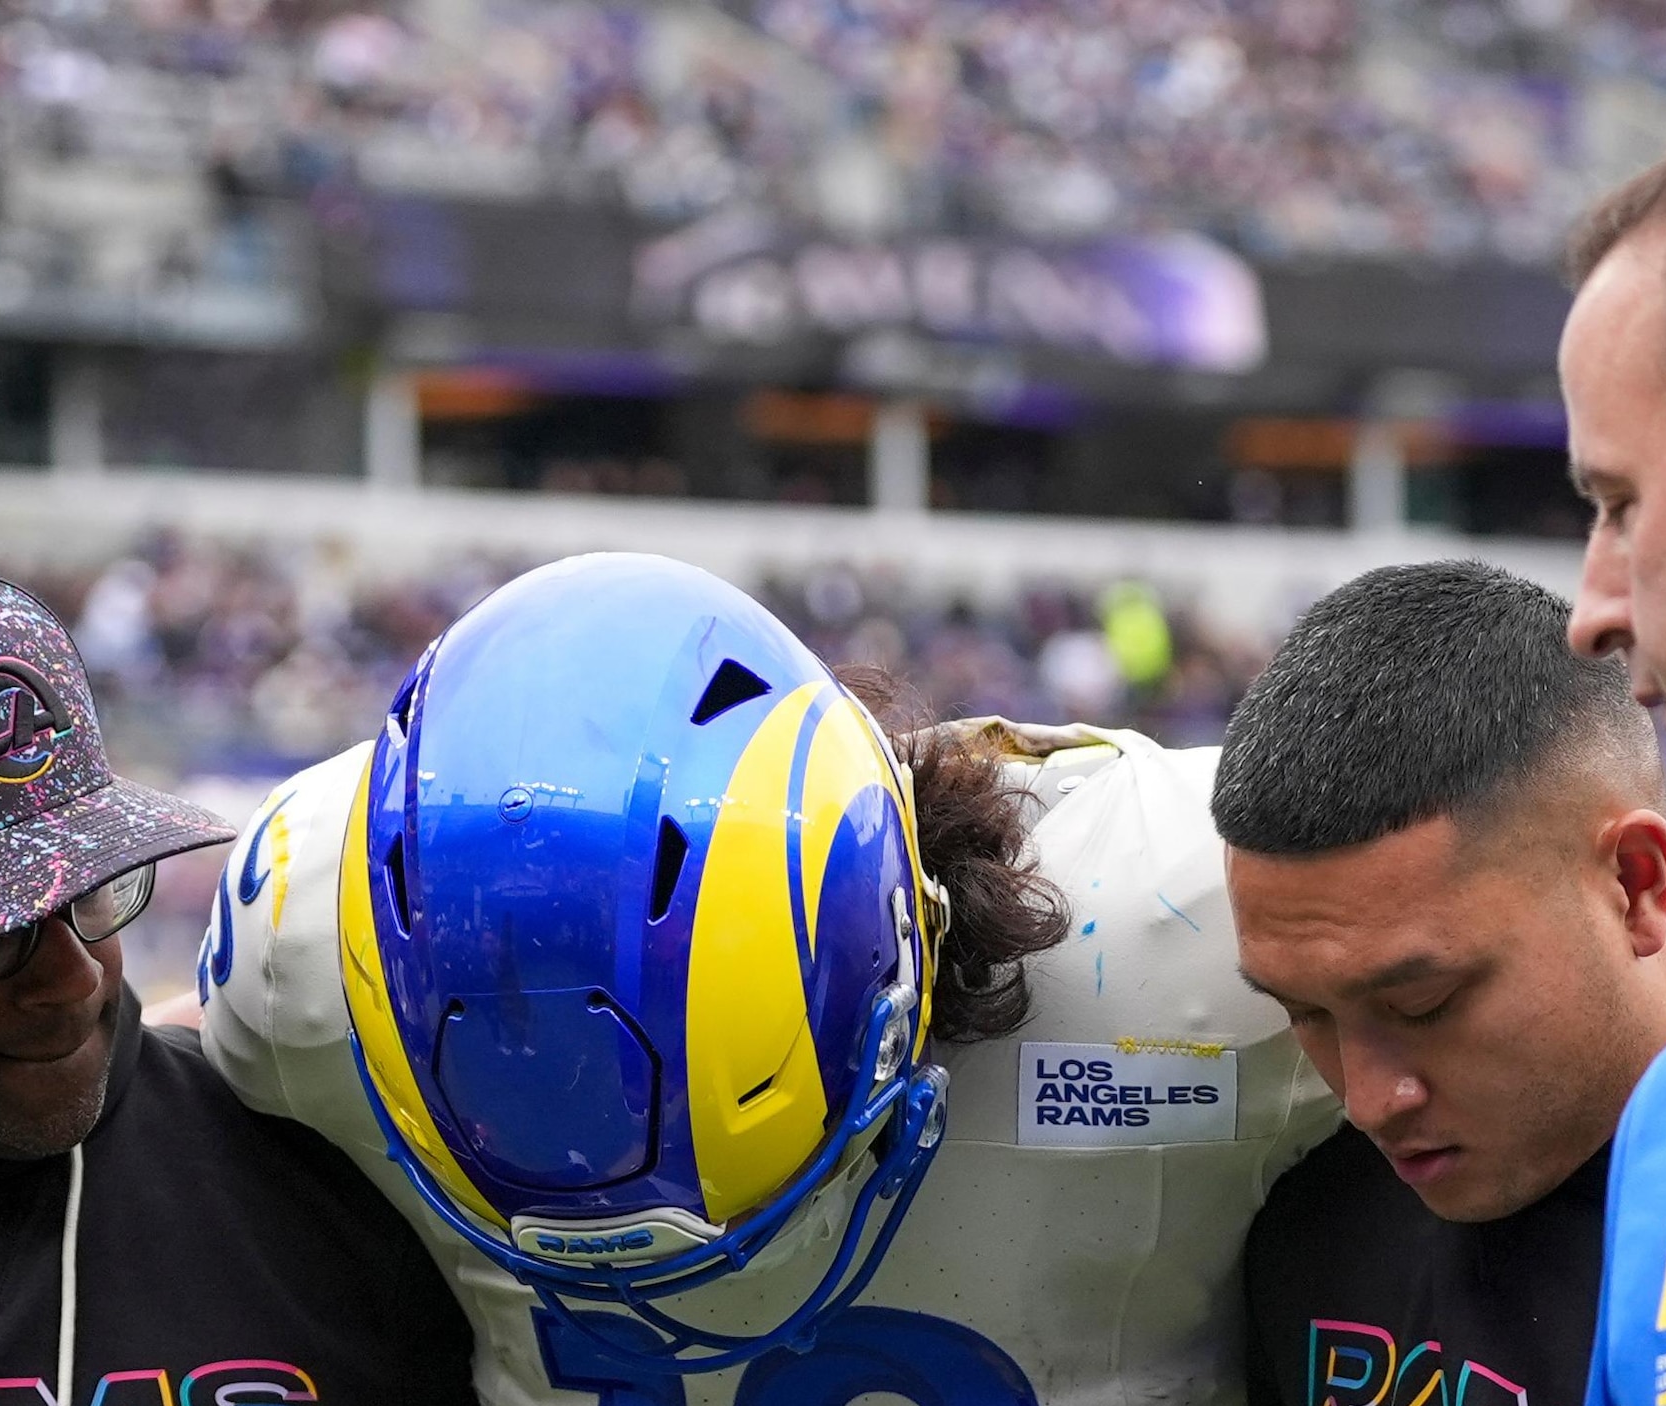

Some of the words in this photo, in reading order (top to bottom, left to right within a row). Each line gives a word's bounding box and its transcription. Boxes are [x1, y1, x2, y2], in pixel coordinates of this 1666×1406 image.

[1036, 1059, 1113, 1082] LOS
[1035, 1083, 1219, 1105] ANGELES
[1036, 1105, 1150, 1127] RAMS
[536, 1229, 654, 1255] RAMS
